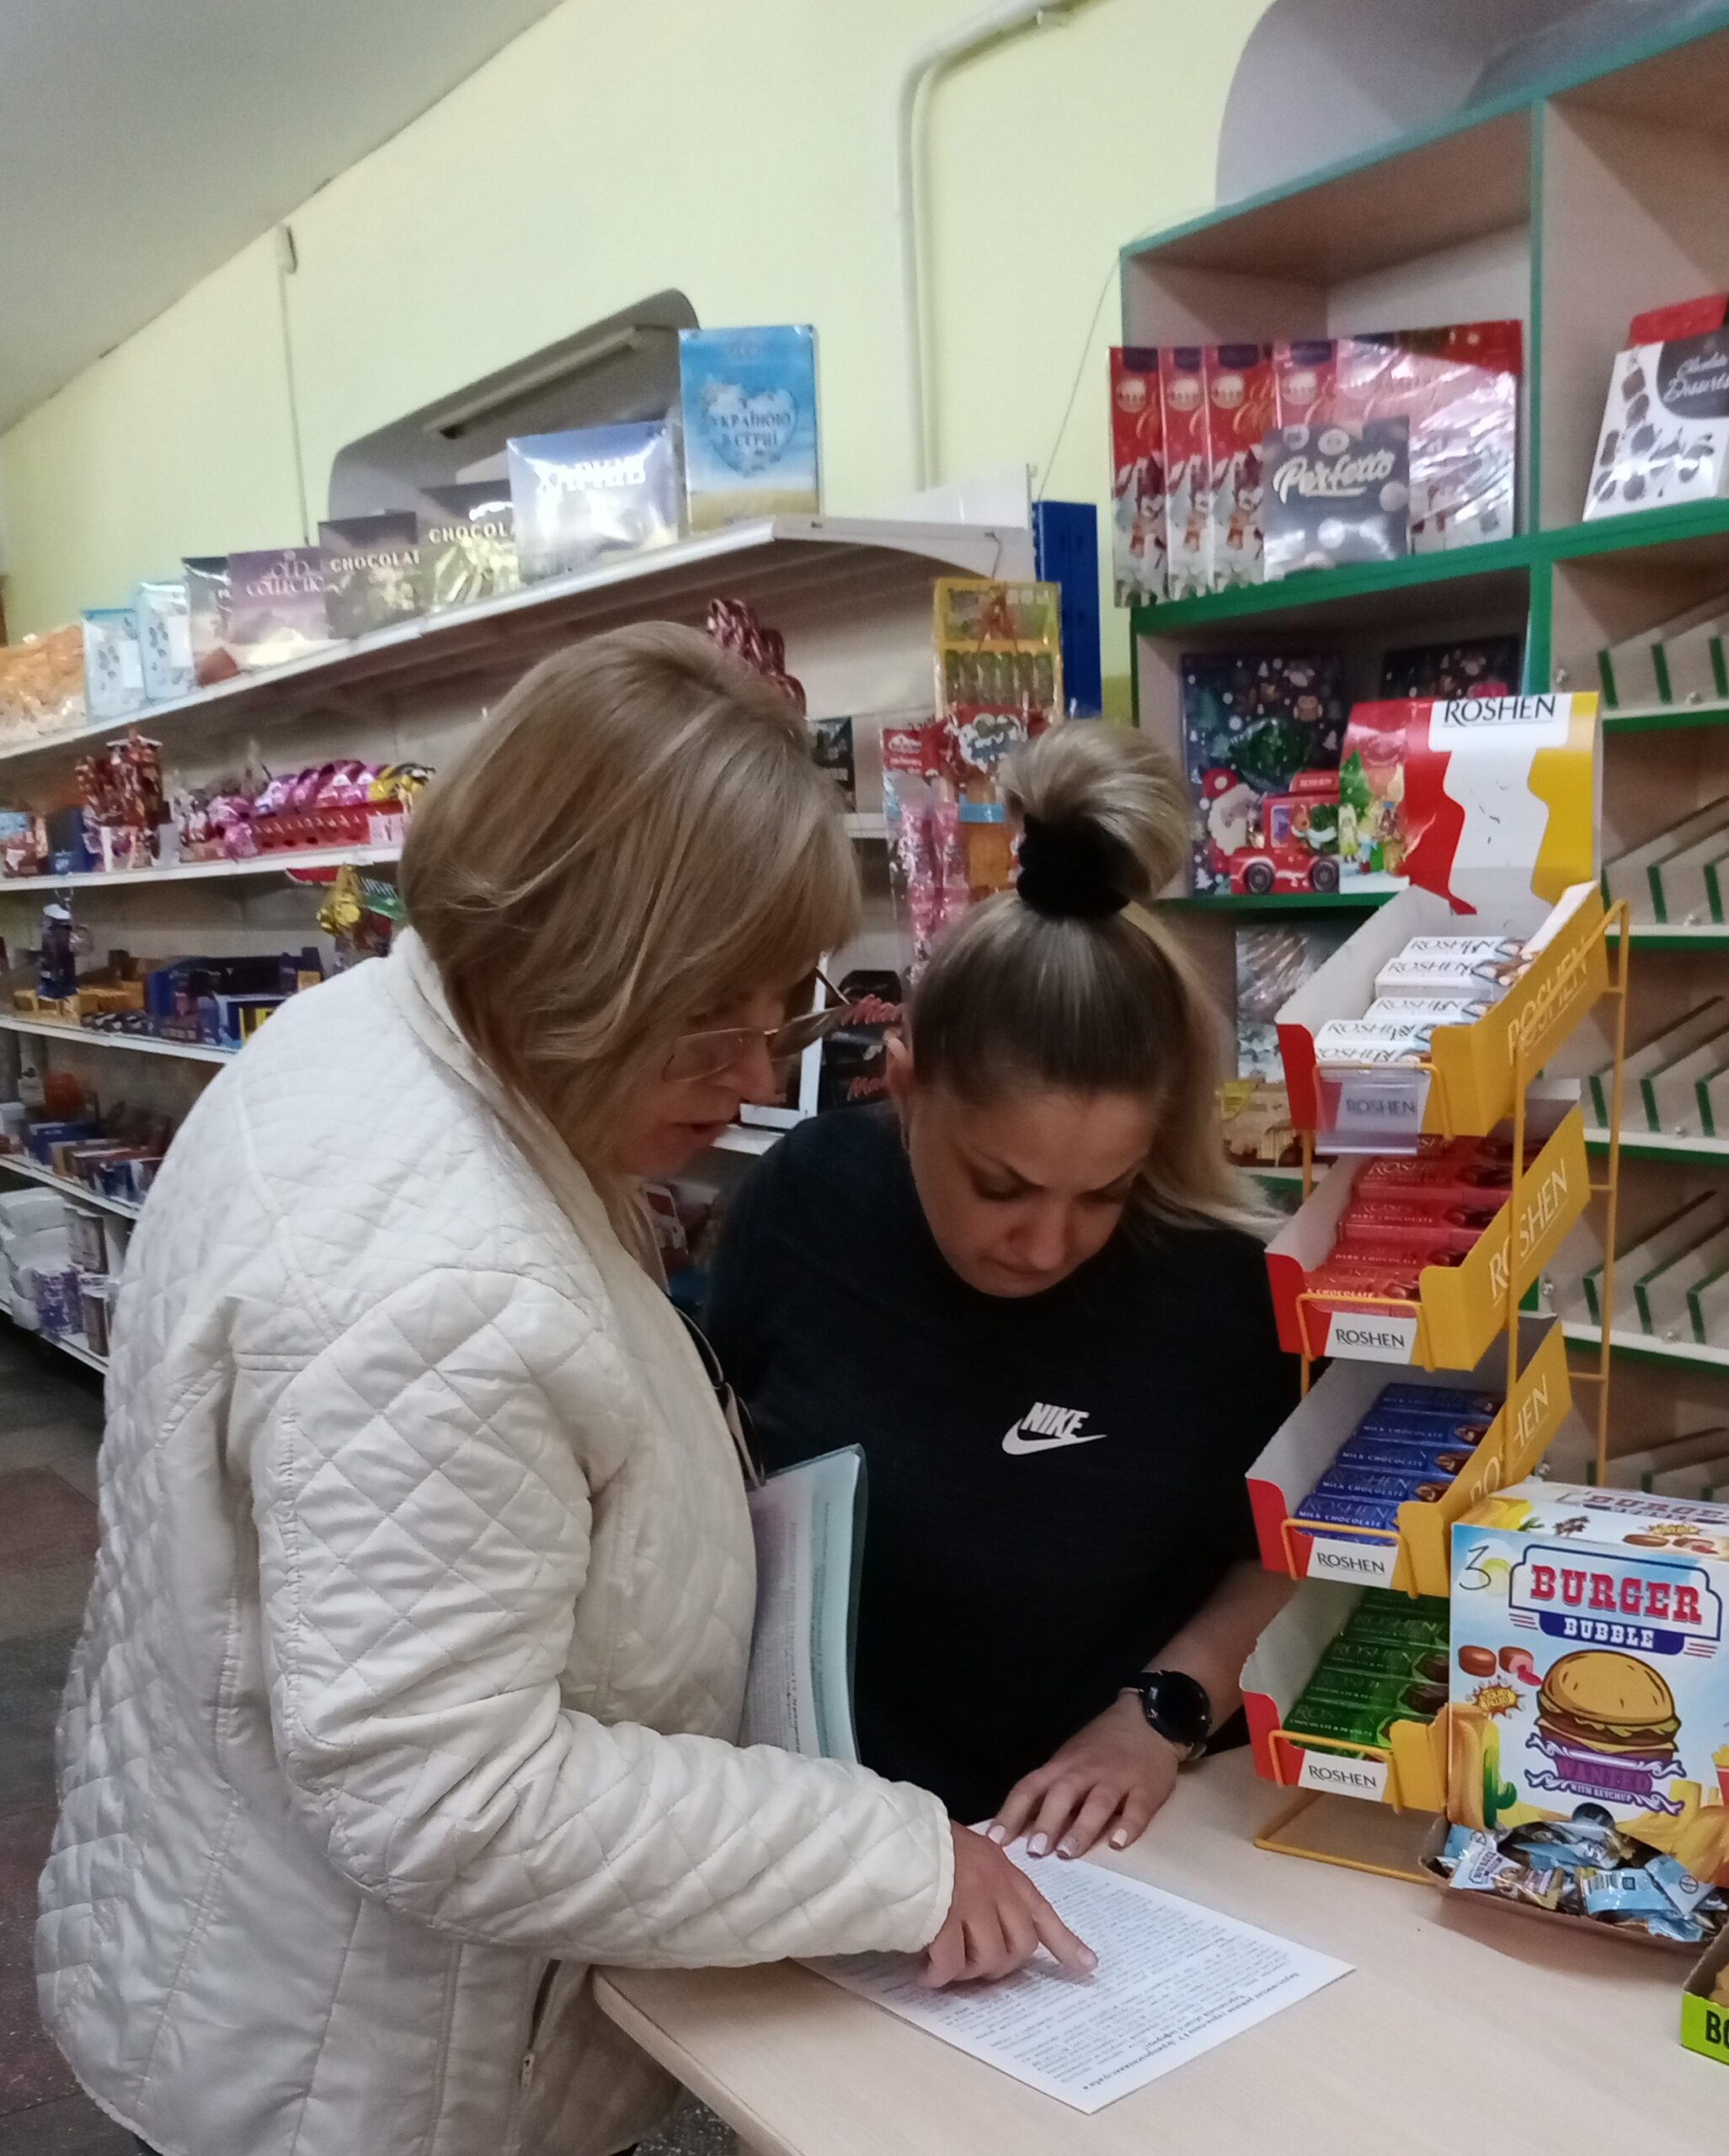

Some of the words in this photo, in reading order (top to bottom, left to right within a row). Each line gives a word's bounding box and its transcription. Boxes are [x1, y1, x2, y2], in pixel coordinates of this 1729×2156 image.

[246, 576, 326, 597] COLLECTIO
[1444, 696, 1556, 727] ROSHEN
[1346, 1098, 1416, 1115] ROSHEN
[1335, 1328, 1406, 1349] ROSHEN
[1020, 1401, 1090, 1438] NIKE
[1347, 1484, 1404, 1497] CHOCOLATE
[1584, 1494, 1729, 1519] BURGE
[1298, 1510, 1321, 1519] MILK
[1325, 1514, 1382, 1528] CHOCOLATE
[1315, 1551, 1386, 1574] ROSHEN
[1530, 1564, 1703, 1625] BURGER
[1563, 1617, 1655, 1649] BUBBLE
[1308, 1764, 1377, 1788] ROSHEN
[1558, 1758, 1650, 1791] WANTED
[1571, 1782, 1593, 1795] WITH
[1593, 1787, 1633, 1803] KETCHUP
